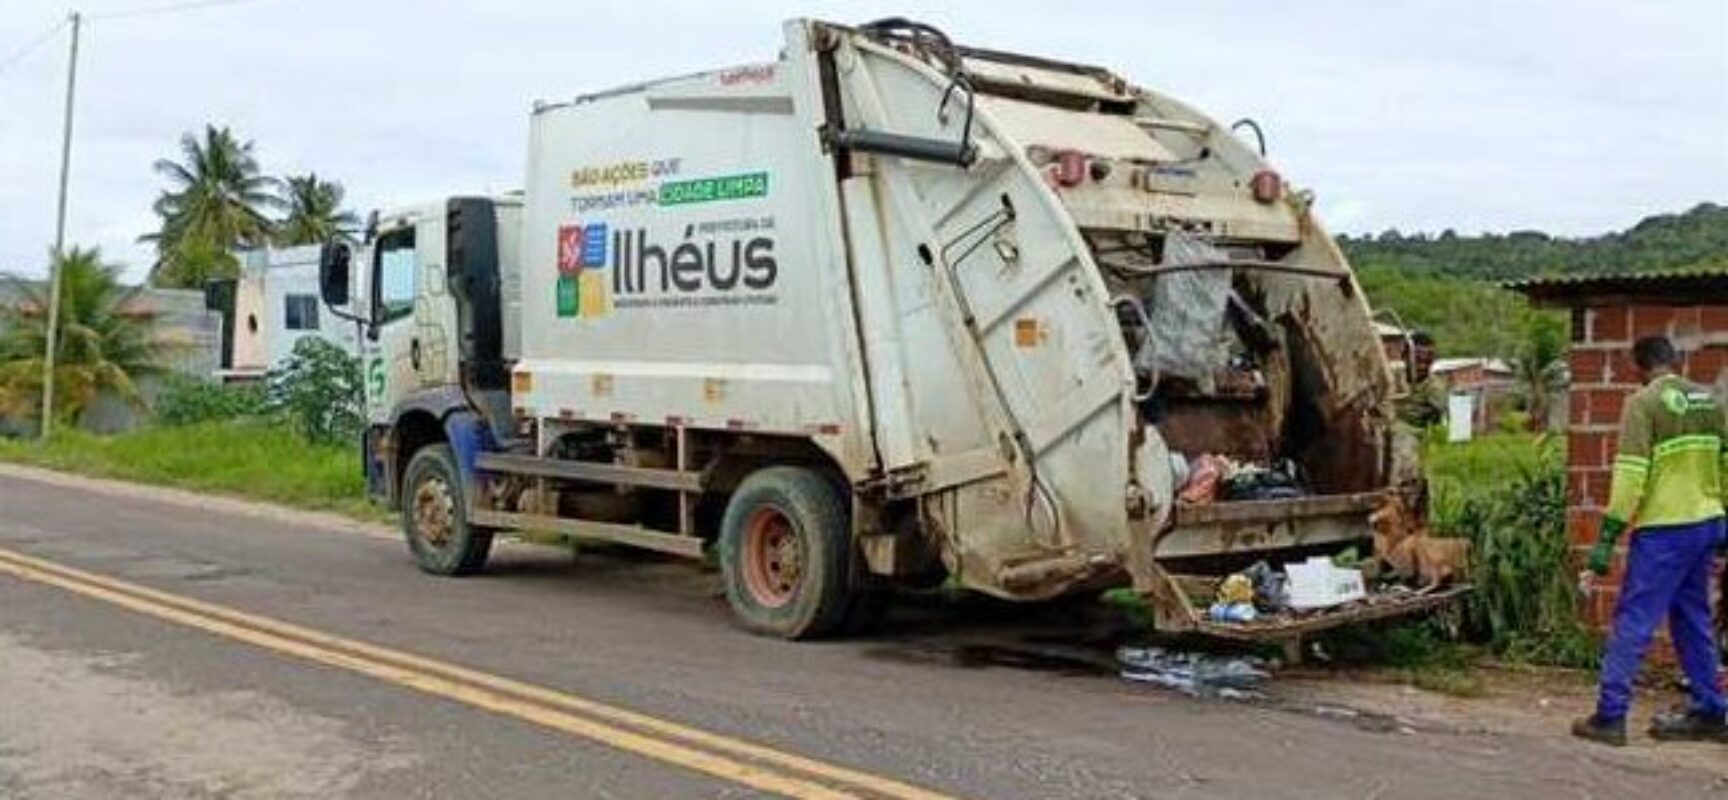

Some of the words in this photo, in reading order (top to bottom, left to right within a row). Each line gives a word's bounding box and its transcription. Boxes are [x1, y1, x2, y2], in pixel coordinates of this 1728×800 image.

[602, 161, 648, 184] AÇÕES
[651, 158, 681, 176] QUE
[627, 189, 657, 205] UMA
[660, 182, 713, 204] CIDADE
[717, 174, 764, 198] LIMPA
[613, 224, 778, 293] Ilhéus
